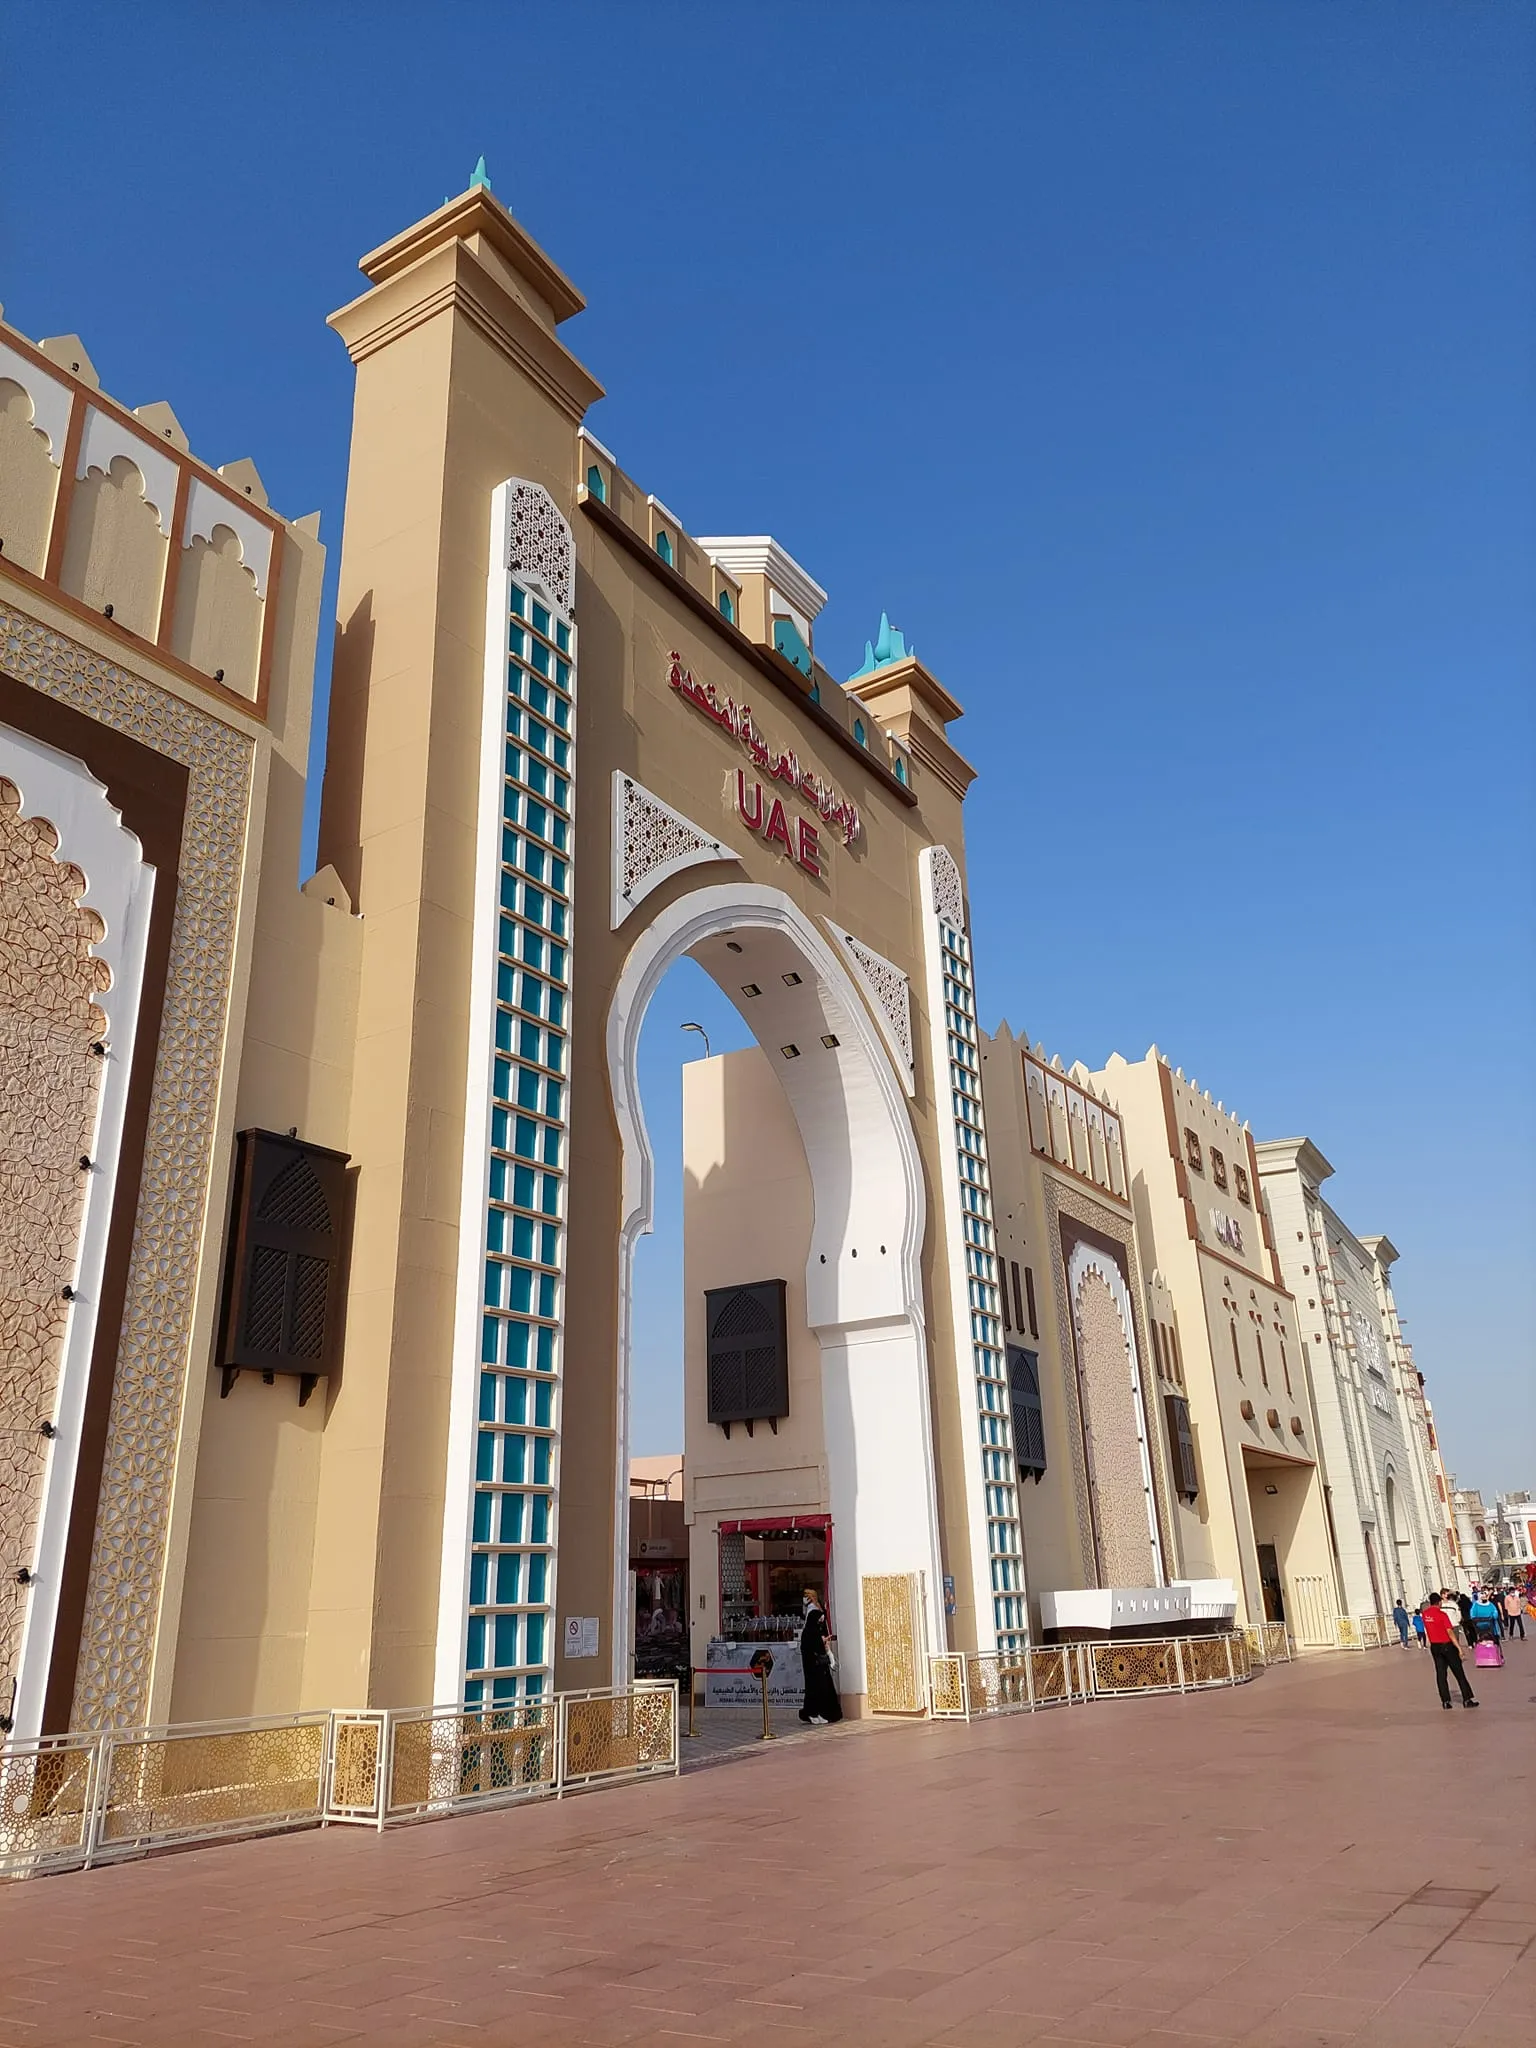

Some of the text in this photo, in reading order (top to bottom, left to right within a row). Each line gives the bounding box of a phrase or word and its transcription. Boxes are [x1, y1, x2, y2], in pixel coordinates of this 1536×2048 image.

[665, 650, 742, 738] المتحدة
[740, 704, 801, 790] العربية
[733, 767, 822, 878] UAE
[1211, 1208, 1244, 1252] UAE
